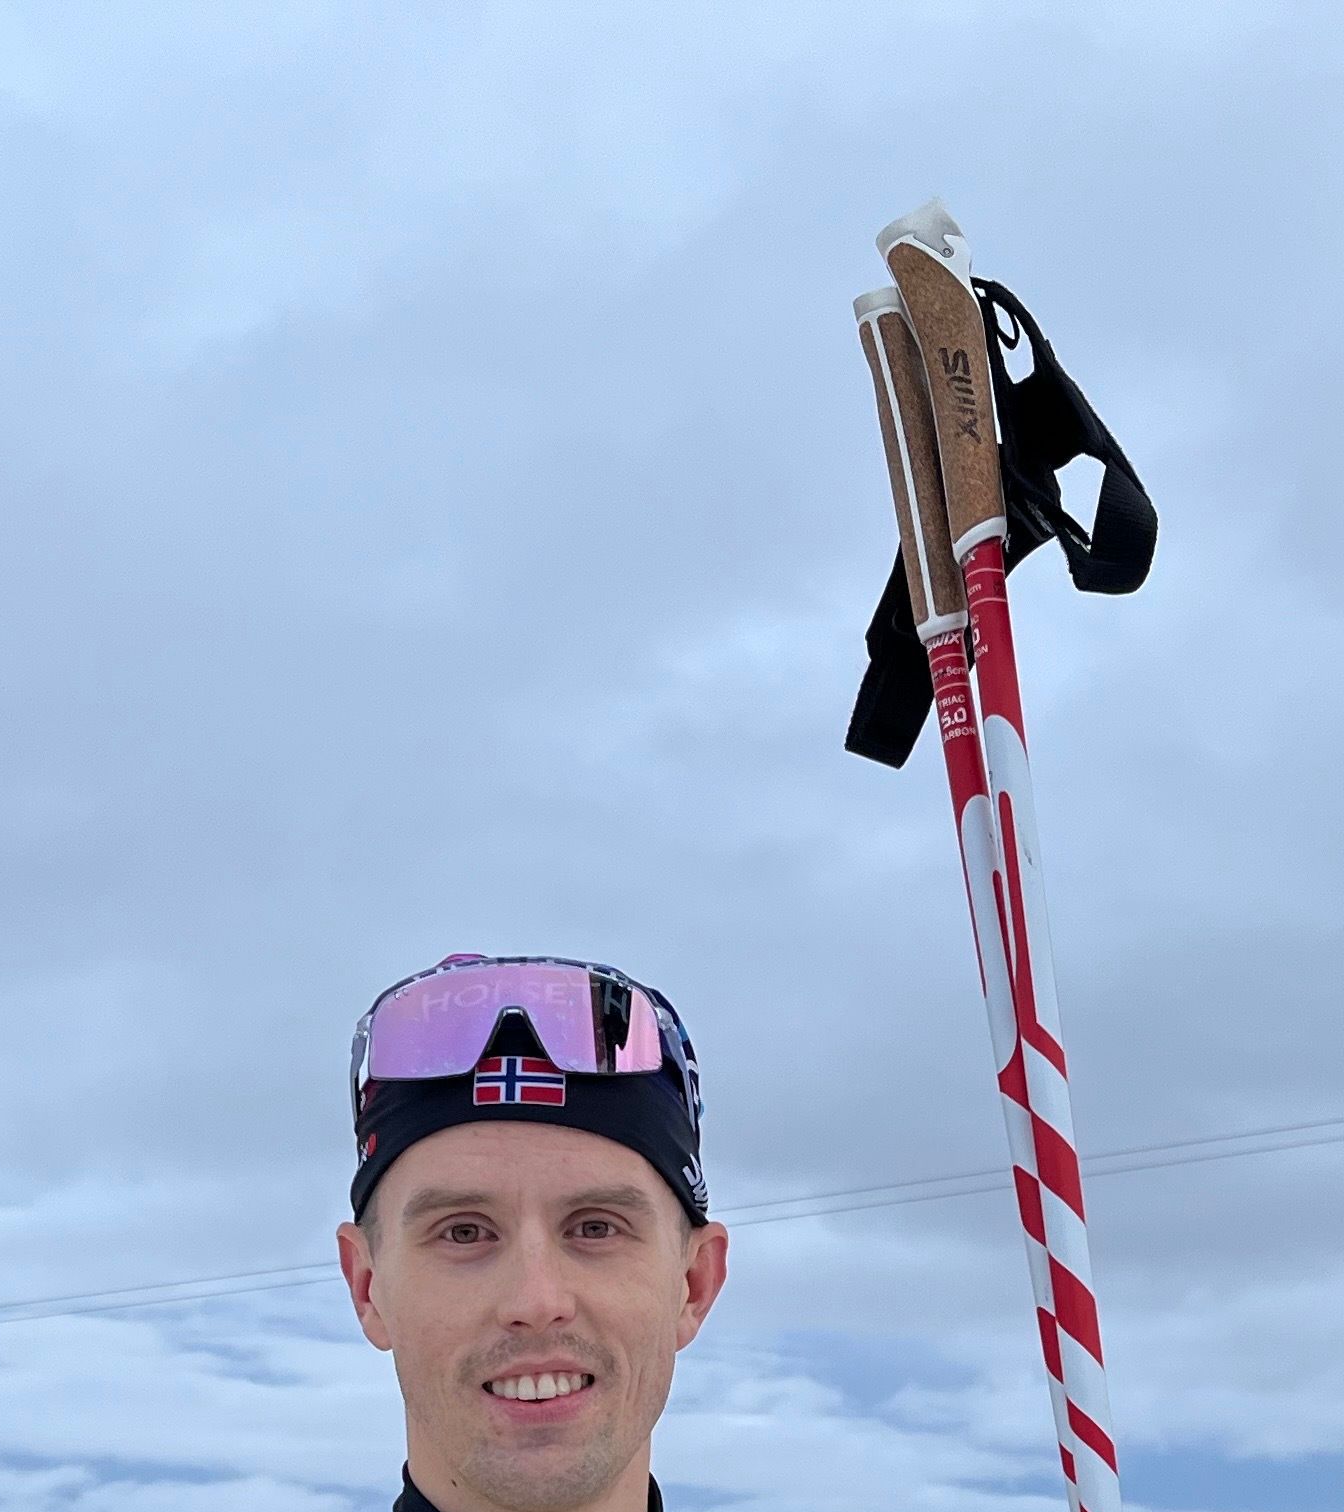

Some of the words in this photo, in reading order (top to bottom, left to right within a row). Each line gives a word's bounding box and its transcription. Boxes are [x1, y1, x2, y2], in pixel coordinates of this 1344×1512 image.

[937, 347, 982, 445] SWIX
[937, 694, 966, 710] TRIAC
[942, 726, 977, 744] ARBON
